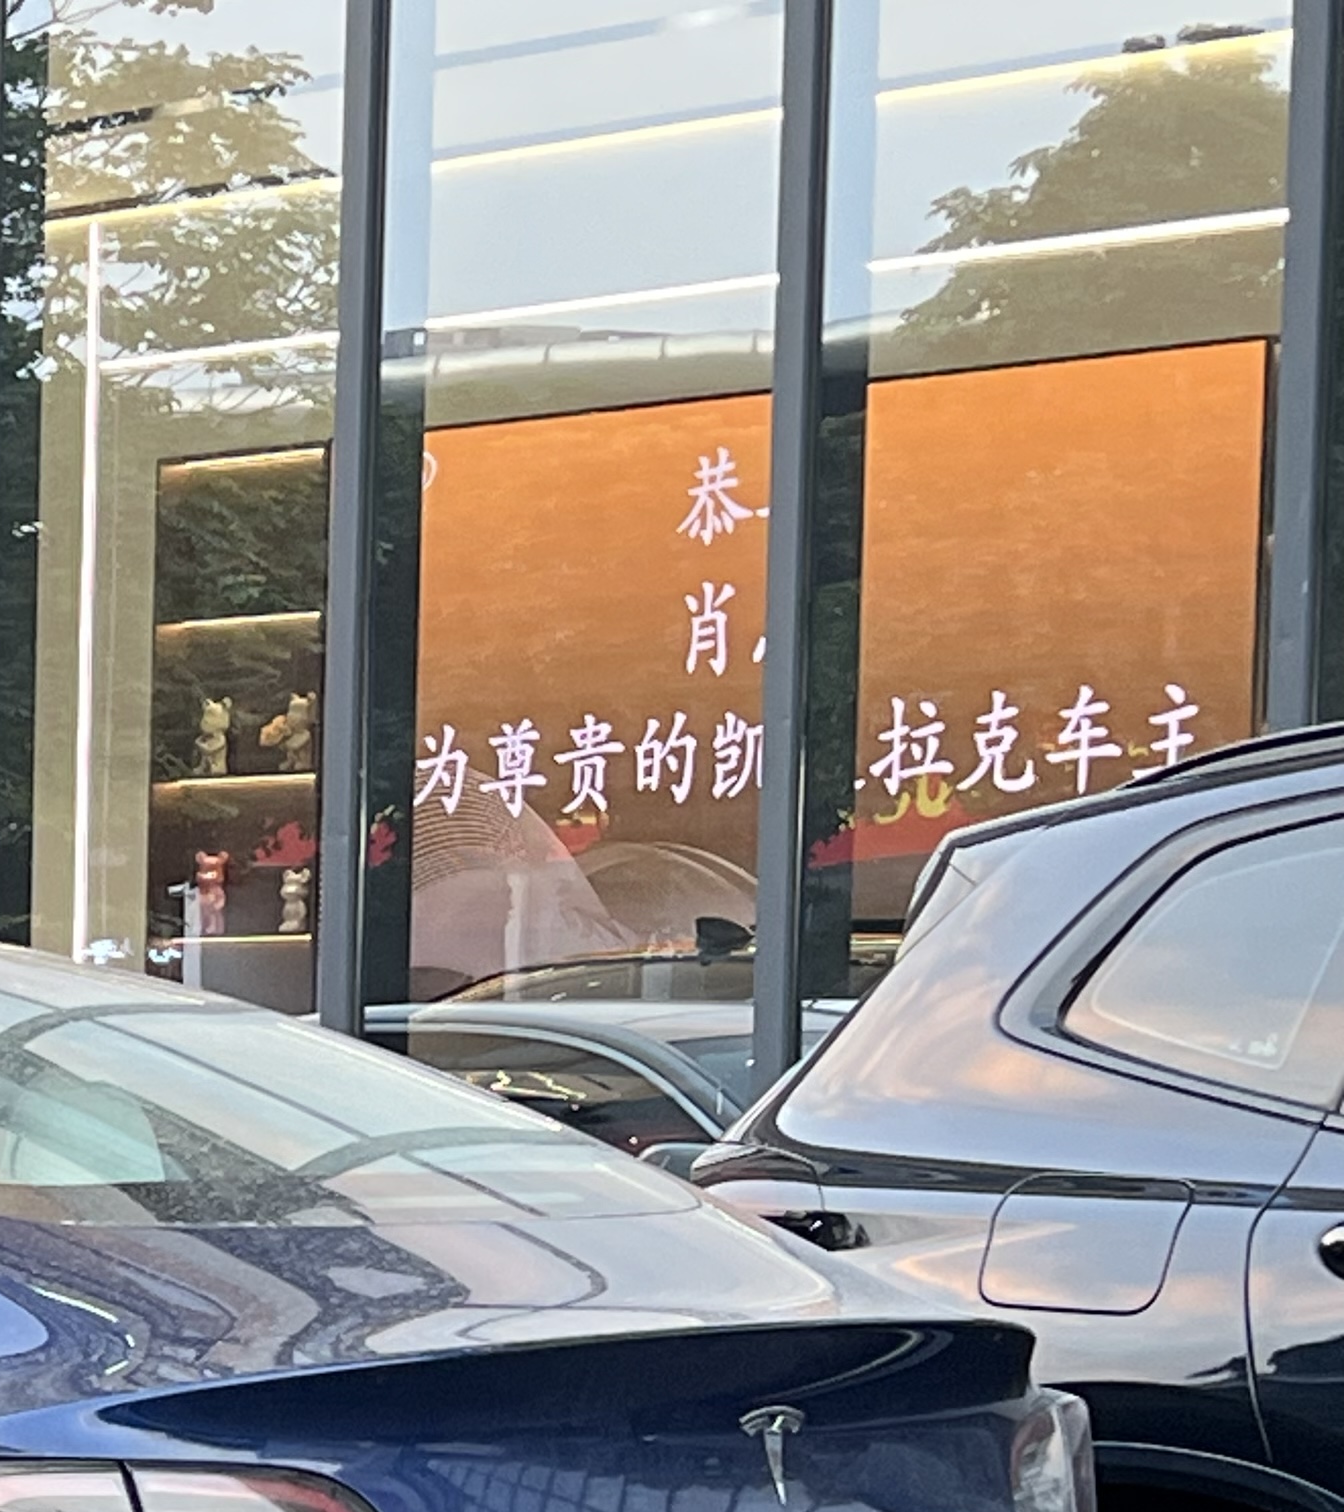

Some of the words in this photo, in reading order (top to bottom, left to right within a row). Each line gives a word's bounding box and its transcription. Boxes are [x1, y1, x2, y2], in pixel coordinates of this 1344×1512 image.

[675, 446, 770, 545] 恭
[684, 581, 766, 676] 肖
[413, 684, 1199, 818] 为尊贵的凯拉克车主
